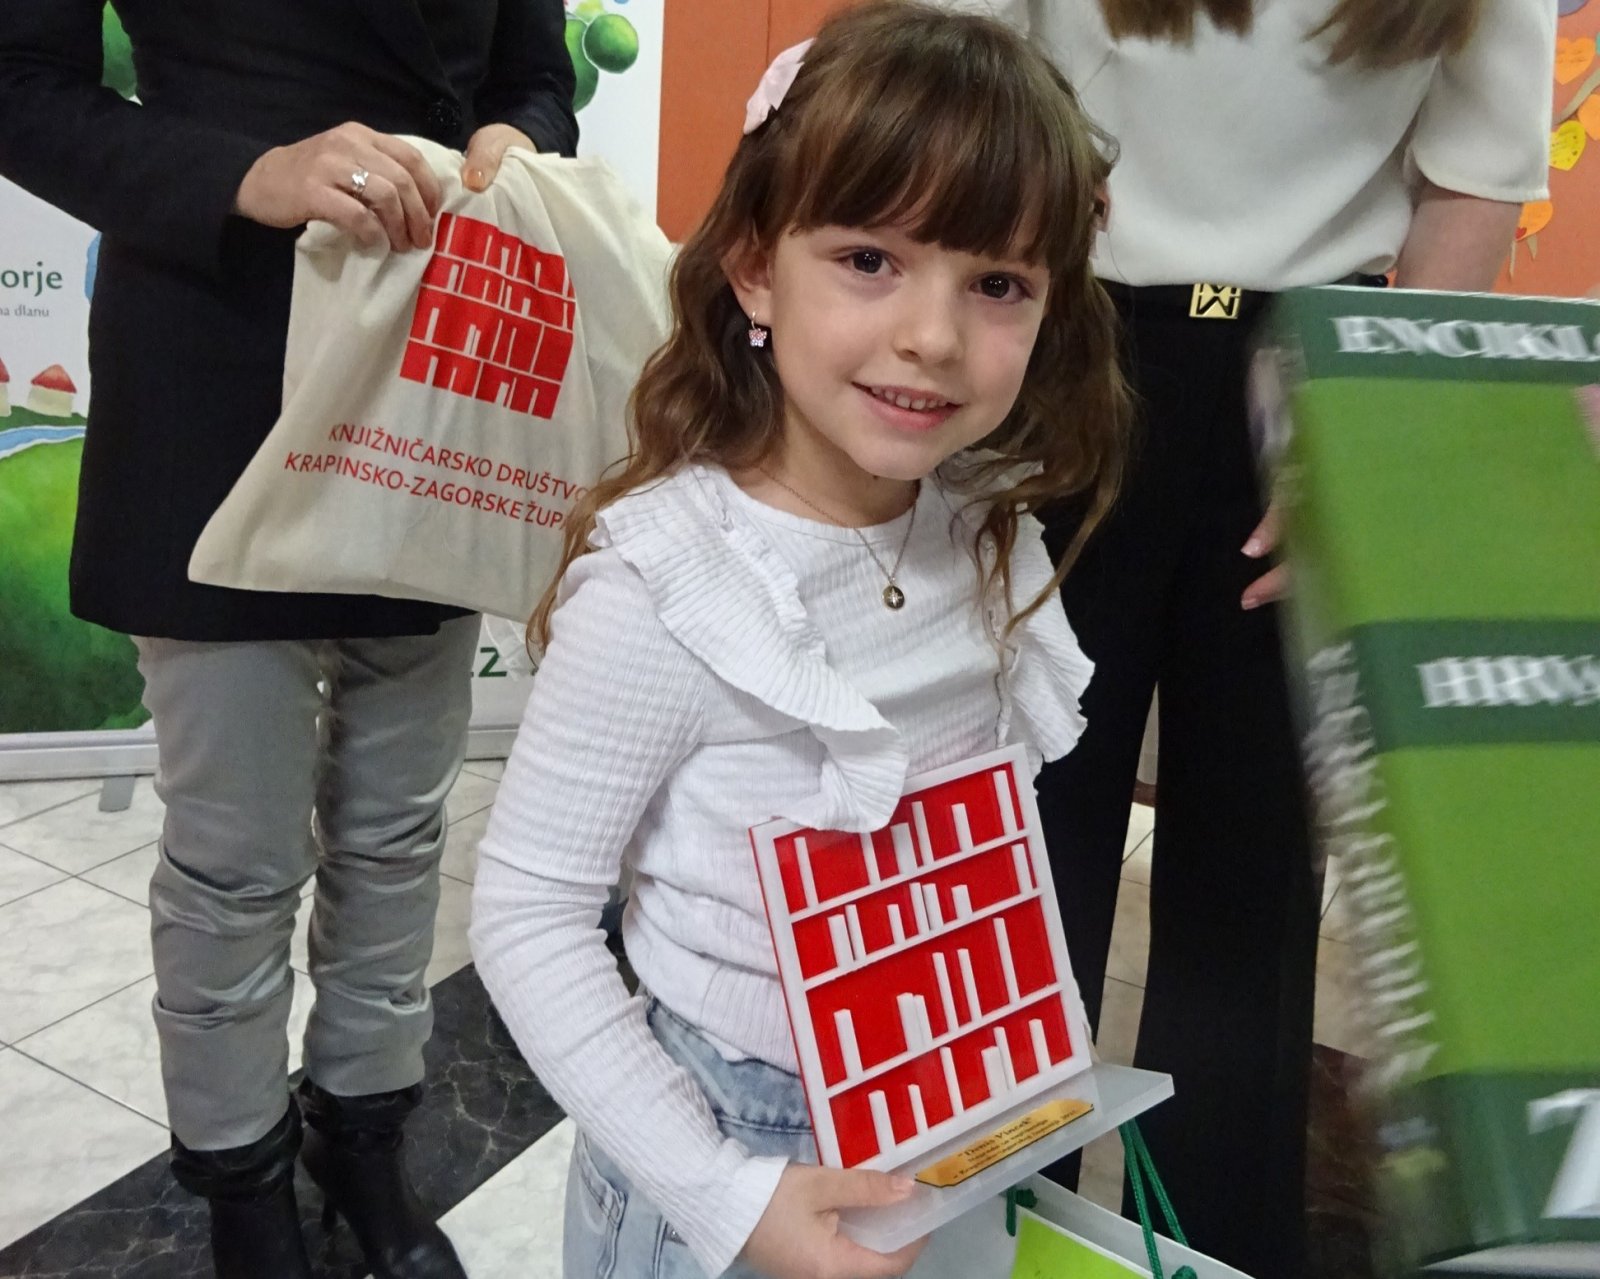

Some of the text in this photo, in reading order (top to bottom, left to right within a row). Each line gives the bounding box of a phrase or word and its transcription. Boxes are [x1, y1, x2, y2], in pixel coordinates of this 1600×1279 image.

[1, 260, 63, 297] orje
[14, 304, 50, 317] dlanu
[1330, 315, 1600, 362] ENCIKL
[328, 422, 493, 478] KNJIŽNIČARSKO
[284, 451, 566, 530] KRAPINSKO-ZAGORSKE ŽUP
